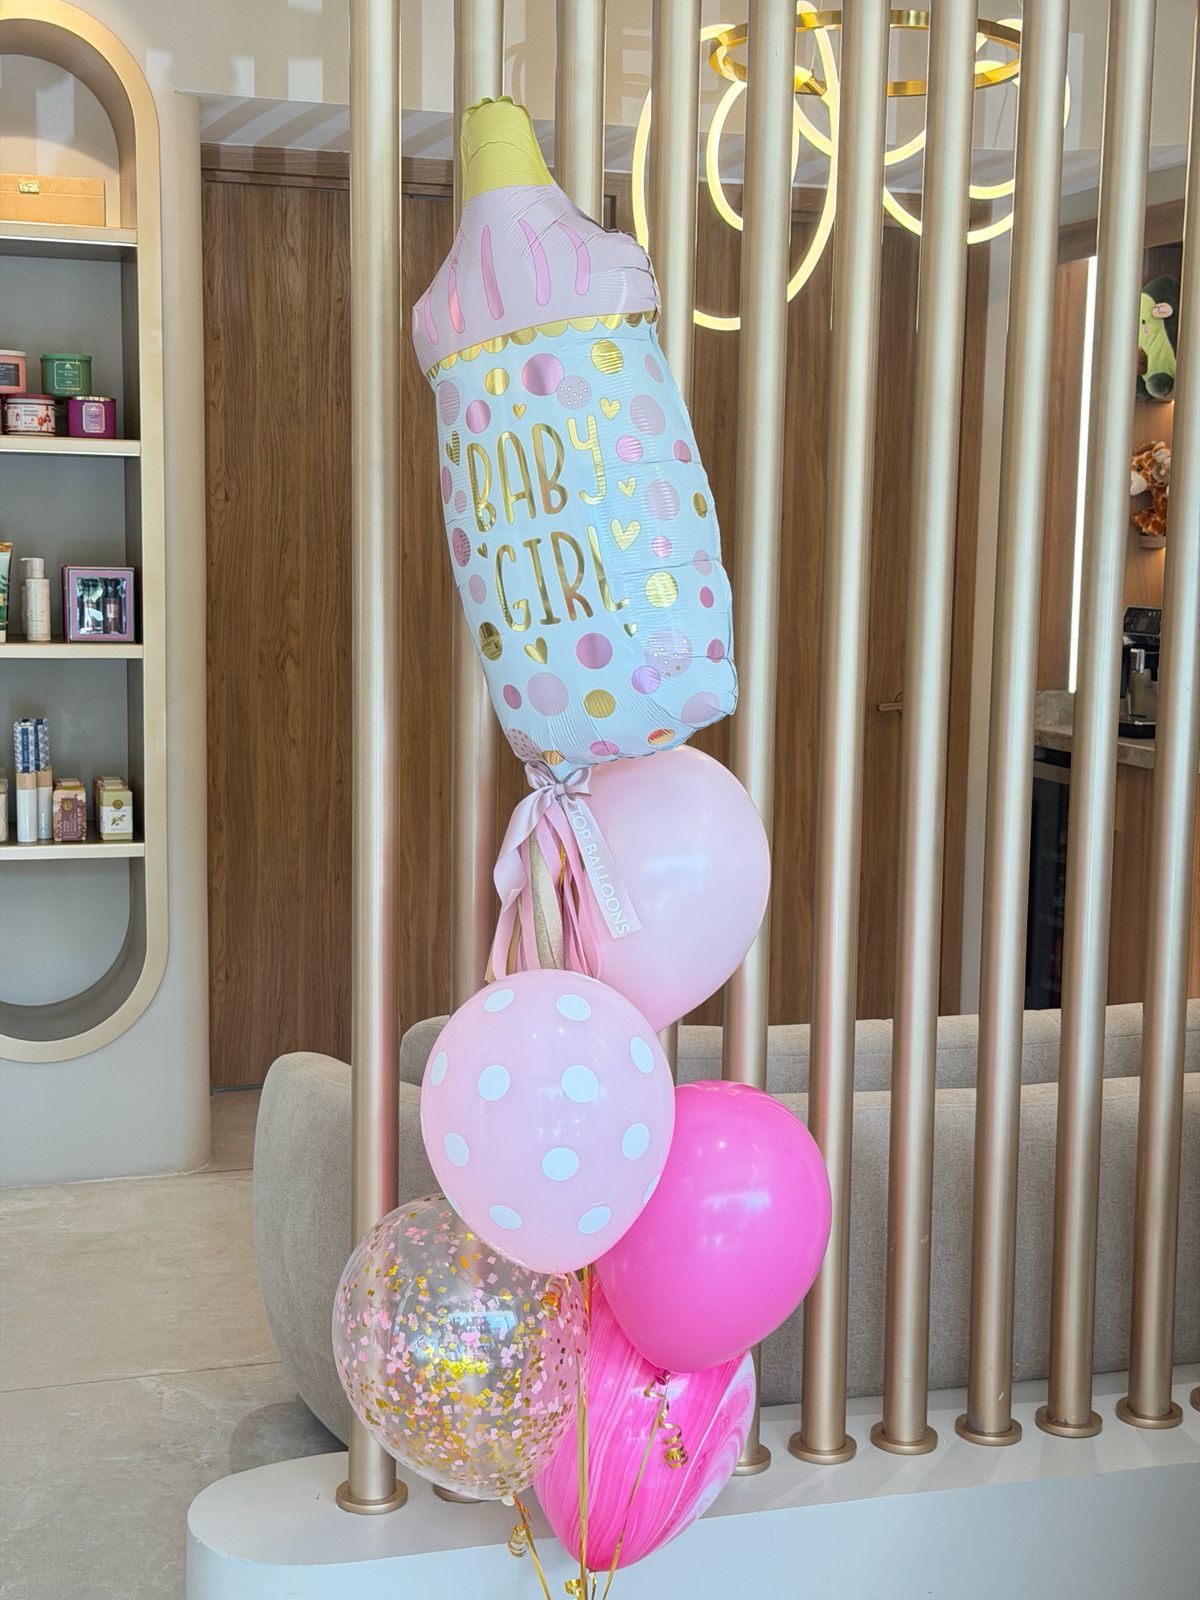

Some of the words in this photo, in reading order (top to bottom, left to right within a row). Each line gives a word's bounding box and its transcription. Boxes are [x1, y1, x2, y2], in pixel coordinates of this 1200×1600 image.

[466, 414, 608, 533] BABY
[495, 524, 632, 633] GIRL
[570, 807, 592, 840] TOP
[586, 844, 630, 935] BALLOONS
